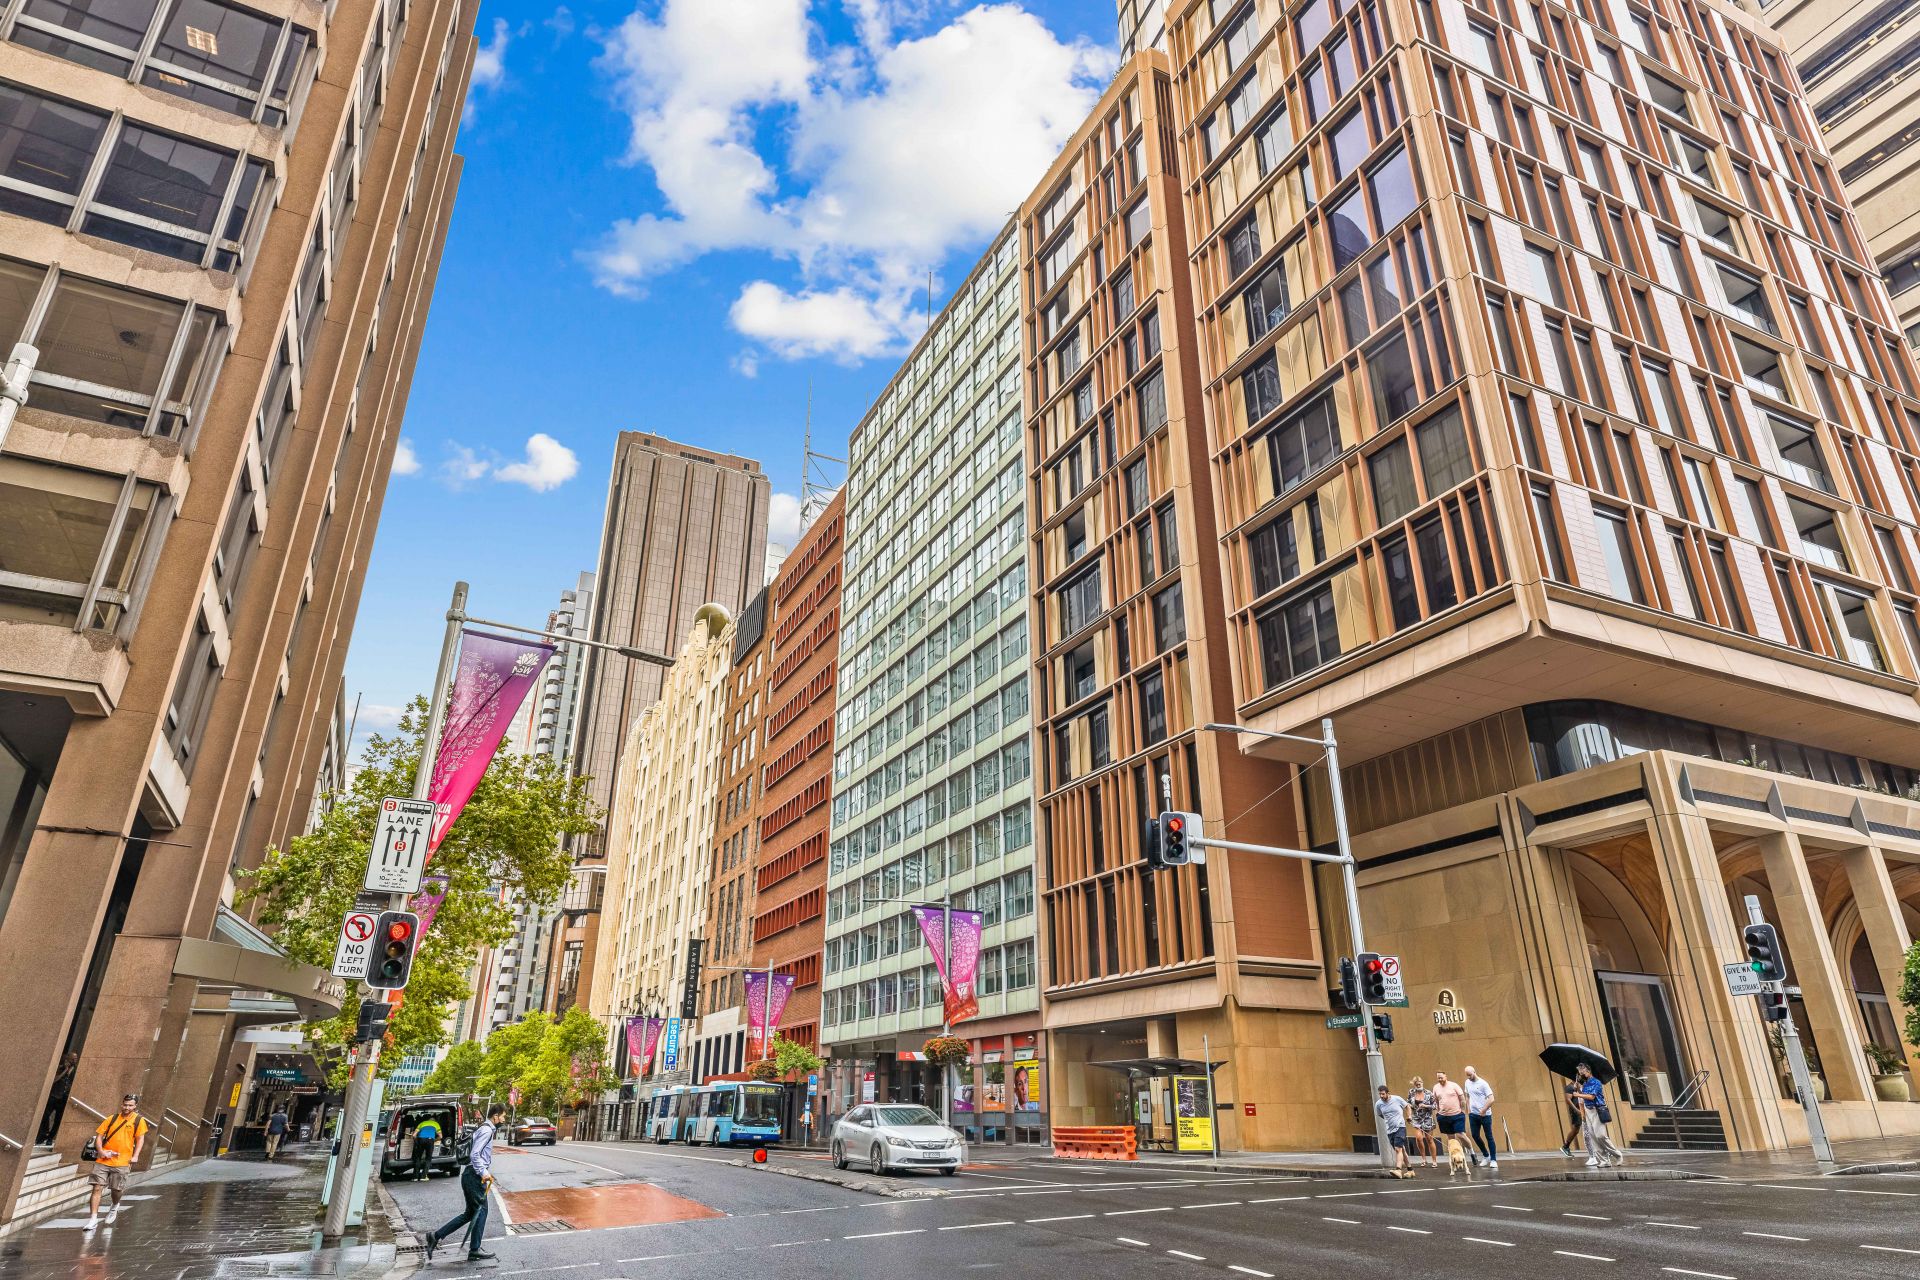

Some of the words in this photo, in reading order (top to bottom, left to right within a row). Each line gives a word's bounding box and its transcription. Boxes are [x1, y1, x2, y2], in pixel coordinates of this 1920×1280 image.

[387, 814, 424, 826] LANE
[344, 944, 364, 955] NO
[341, 956, 364, 964] LEFT
[338, 966, 363, 974] TURN
[1726, 966, 1740, 974] GIVE
[1732, 983, 1760, 992] PEDESTRIANS
[1332, 1016, 1352, 1025] Elizabeth
[1433, 1009, 1465, 1025] BARED
